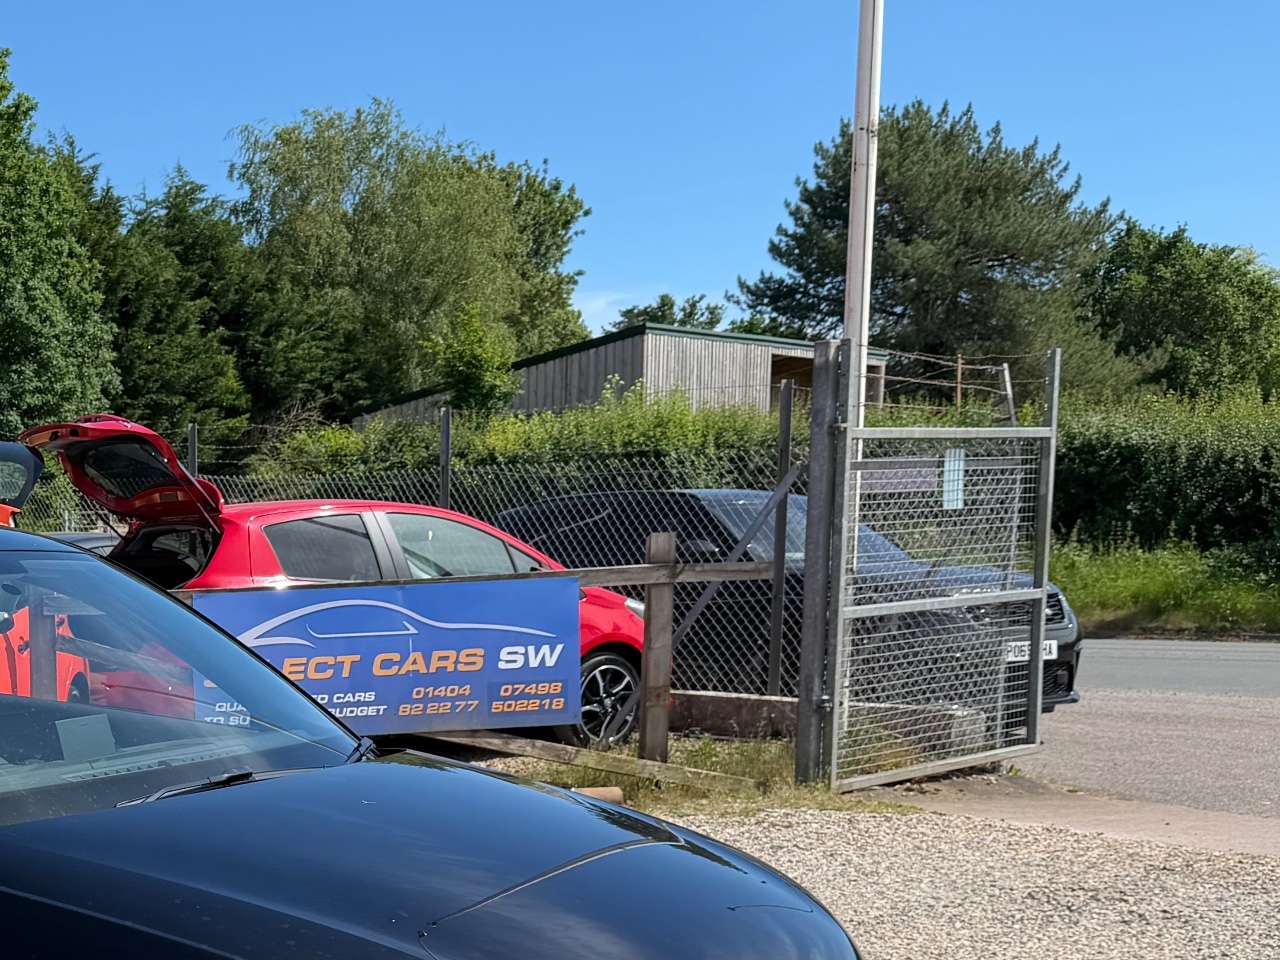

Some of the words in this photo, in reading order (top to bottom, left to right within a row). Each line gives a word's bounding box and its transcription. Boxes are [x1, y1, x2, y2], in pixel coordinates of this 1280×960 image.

[282, 654, 361, 681] ECT
[372, 648, 485, 677] CARS
[498, 643, 565, 670] SW
[333, 692, 376, 703] CARS
[412, 684, 472, 699] 01404
[500, 682, 563, 697] 07498
[491, 698, 564, 713] 502218
